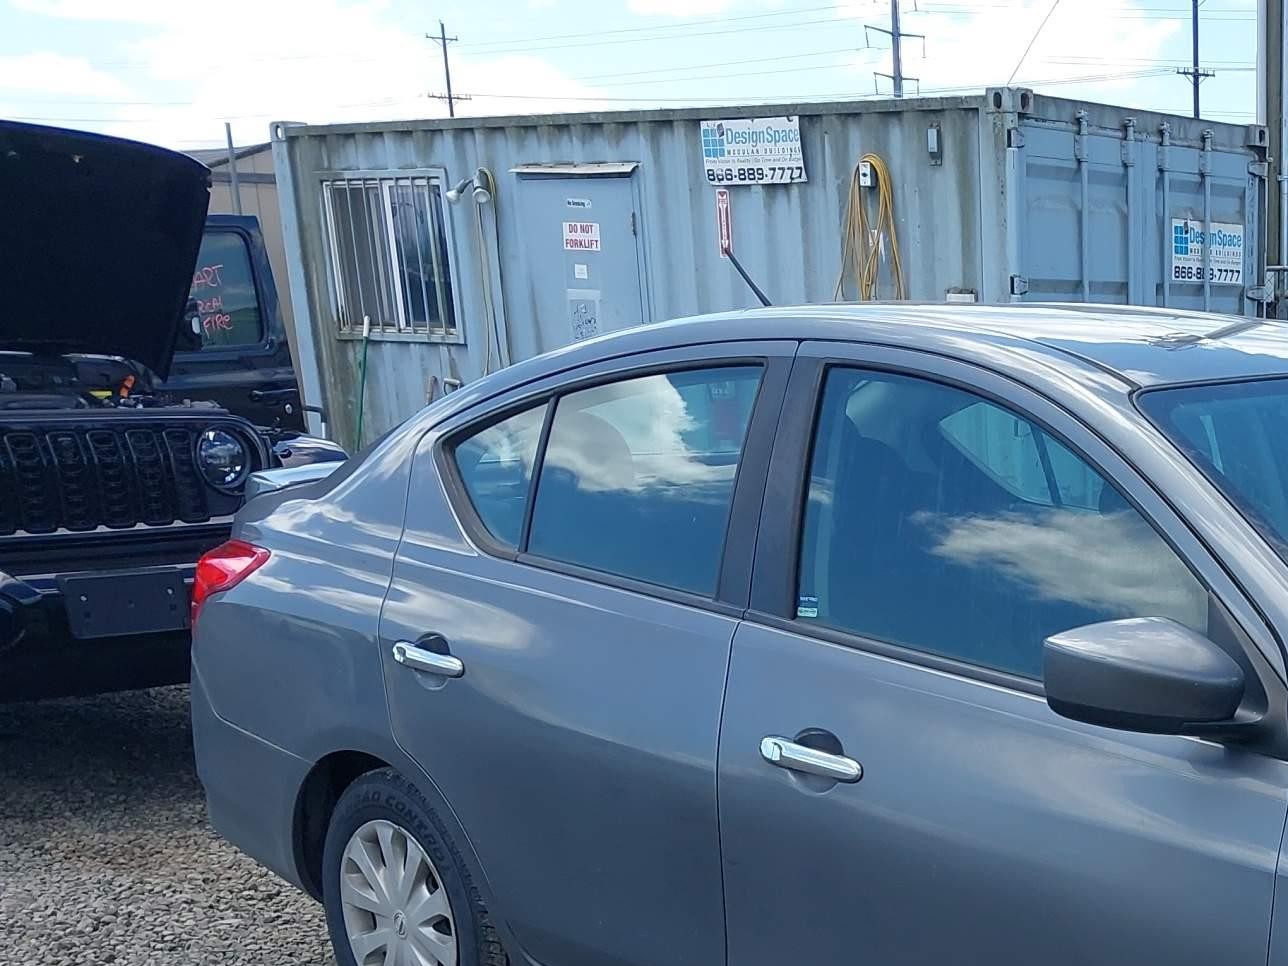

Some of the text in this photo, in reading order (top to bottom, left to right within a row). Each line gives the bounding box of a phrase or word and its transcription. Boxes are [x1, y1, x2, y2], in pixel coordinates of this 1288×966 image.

[726, 126, 799, 148] DesignSpace
[568, 224, 594, 234] DO NOT
[1190, 226, 1242, 248] DesnSpace
[565, 239, 599, 249] FORKLIFT
[1174, 266, 1241, 282] 866-89-7777
